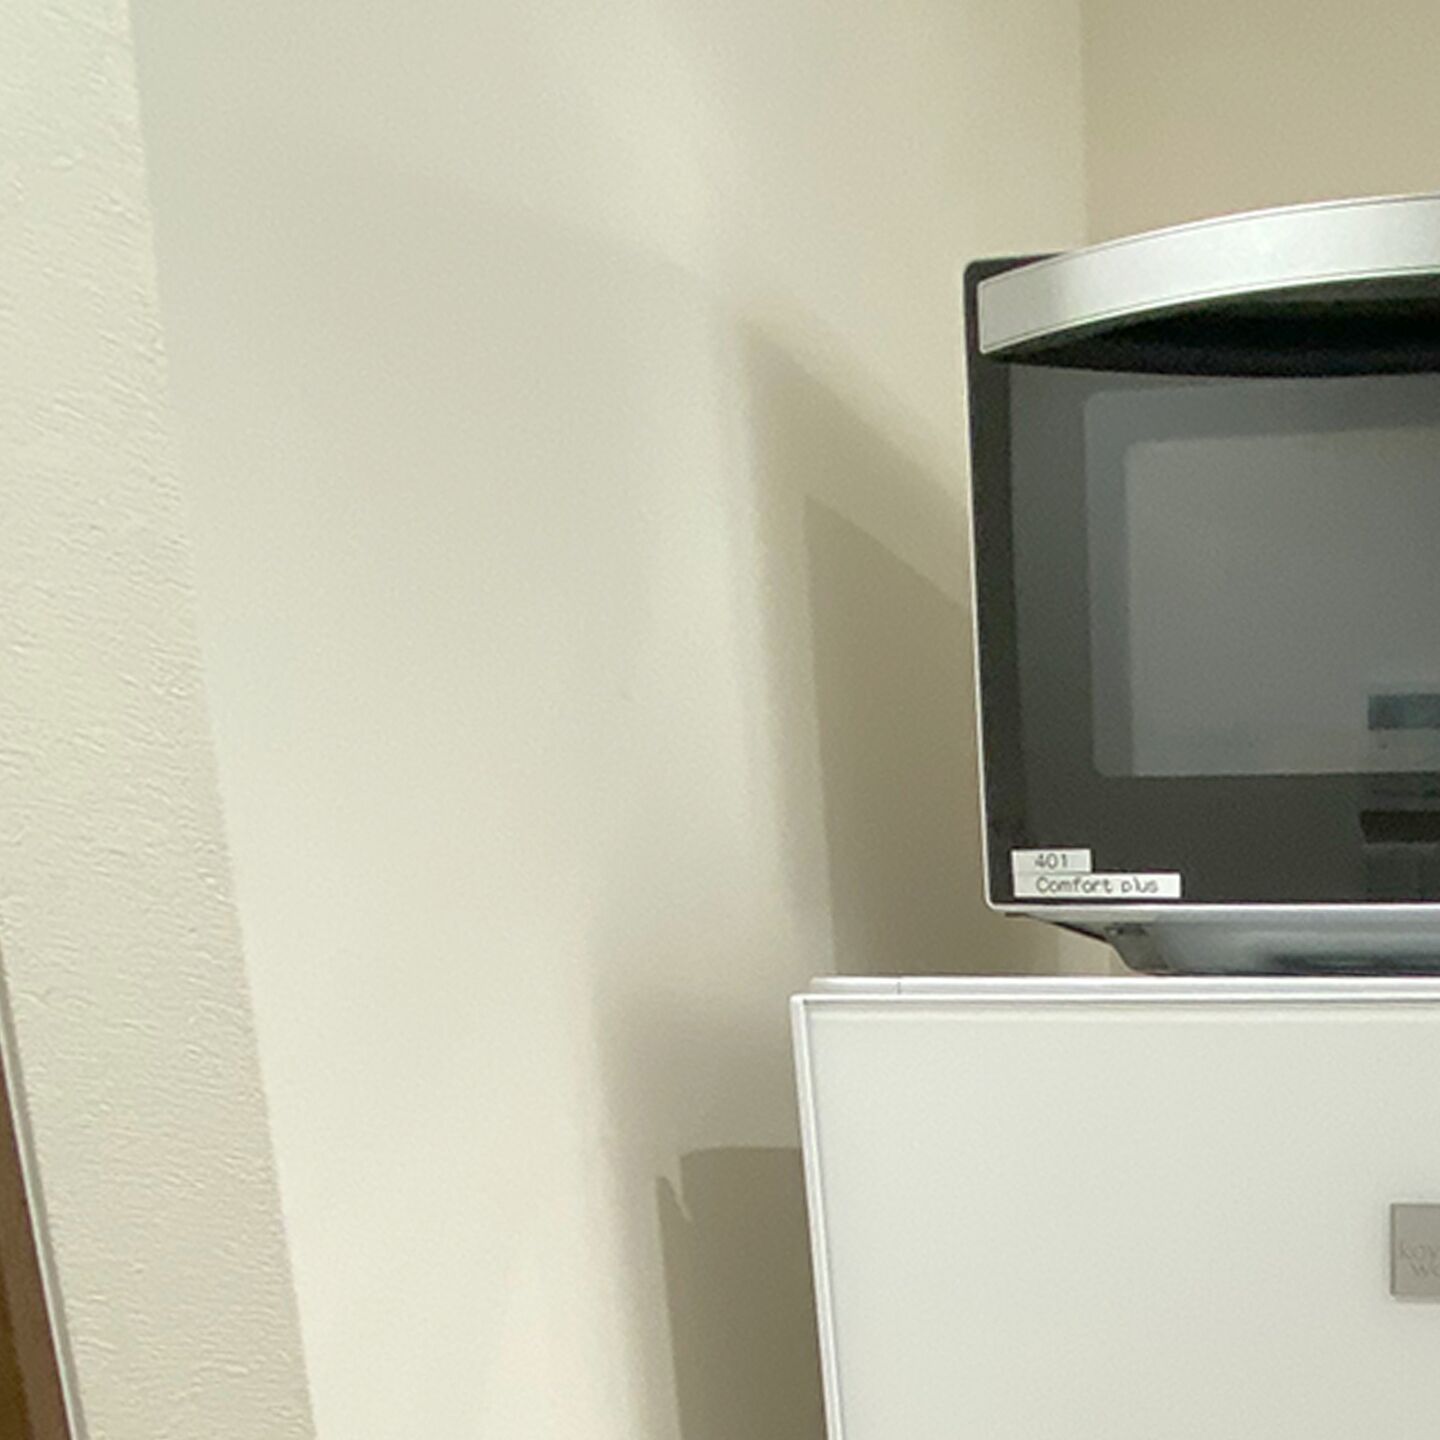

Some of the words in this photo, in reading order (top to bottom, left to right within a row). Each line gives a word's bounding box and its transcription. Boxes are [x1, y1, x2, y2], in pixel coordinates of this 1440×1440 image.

[1034, 853, 1068, 869] 401
[1036, 876, 1113, 894] Comfort
[1121, 876, 1160, 894] plus
